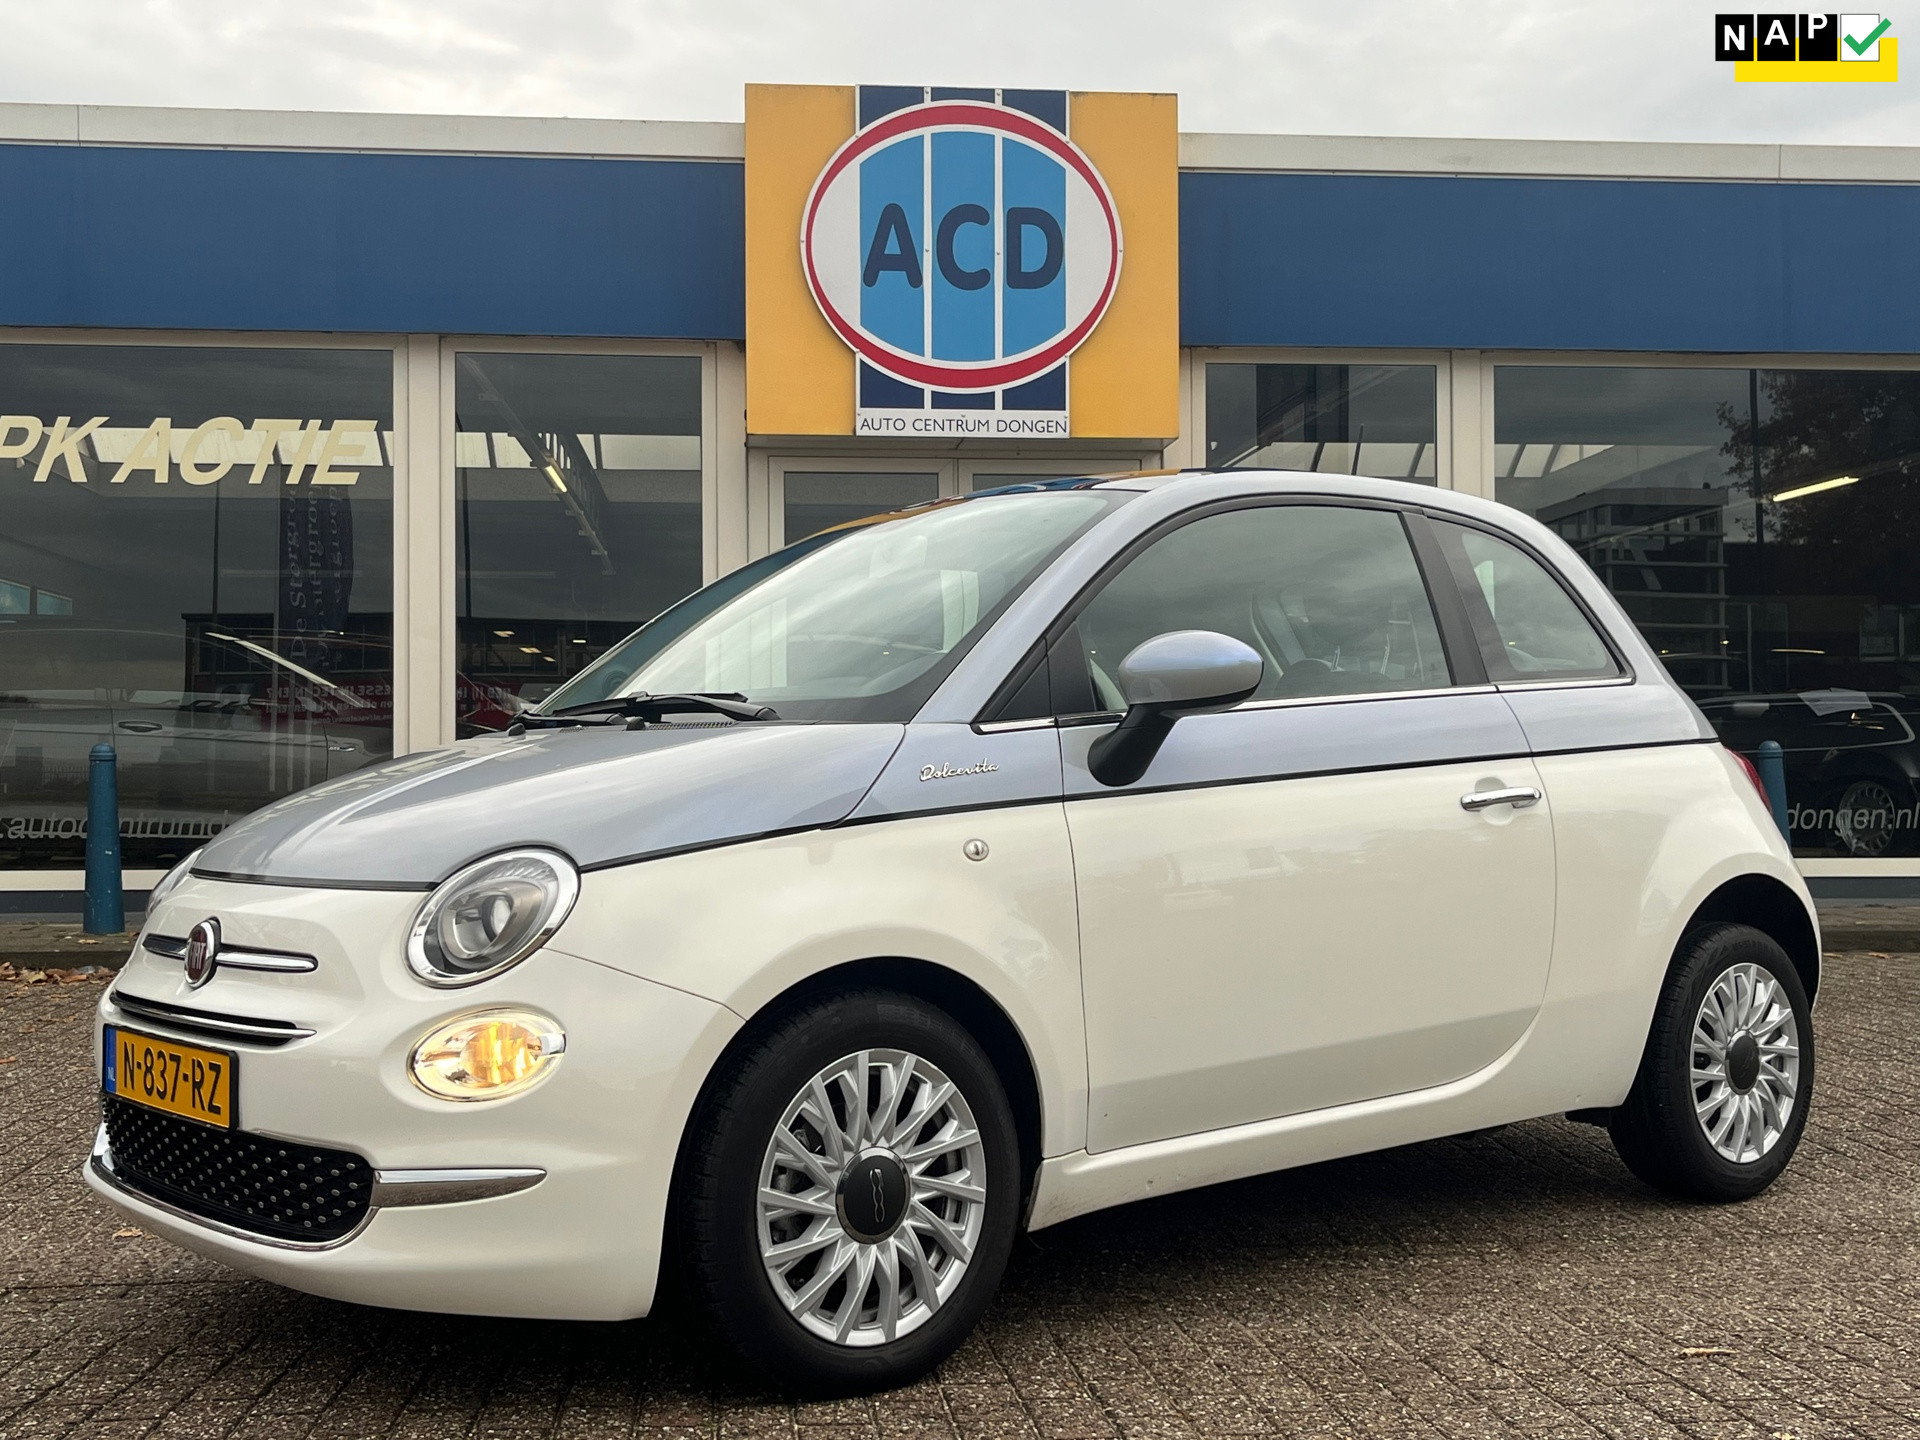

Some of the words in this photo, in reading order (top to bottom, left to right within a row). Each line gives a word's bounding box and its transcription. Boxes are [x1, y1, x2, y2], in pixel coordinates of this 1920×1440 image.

[863, 202, 1064, 291] ACD
[860, 417, 906, 432] AUTO
[912, 418, 990, 433] CENTRUM
[996, 419, 1067, 434] DONGEN
[110, 416, 378, 486] ACTIE
[920, 758, 999, 781] Dolcevita
[107, 1066, 116, 1082] NL
[124, 1041, 222, 1116] N-837-RZ
